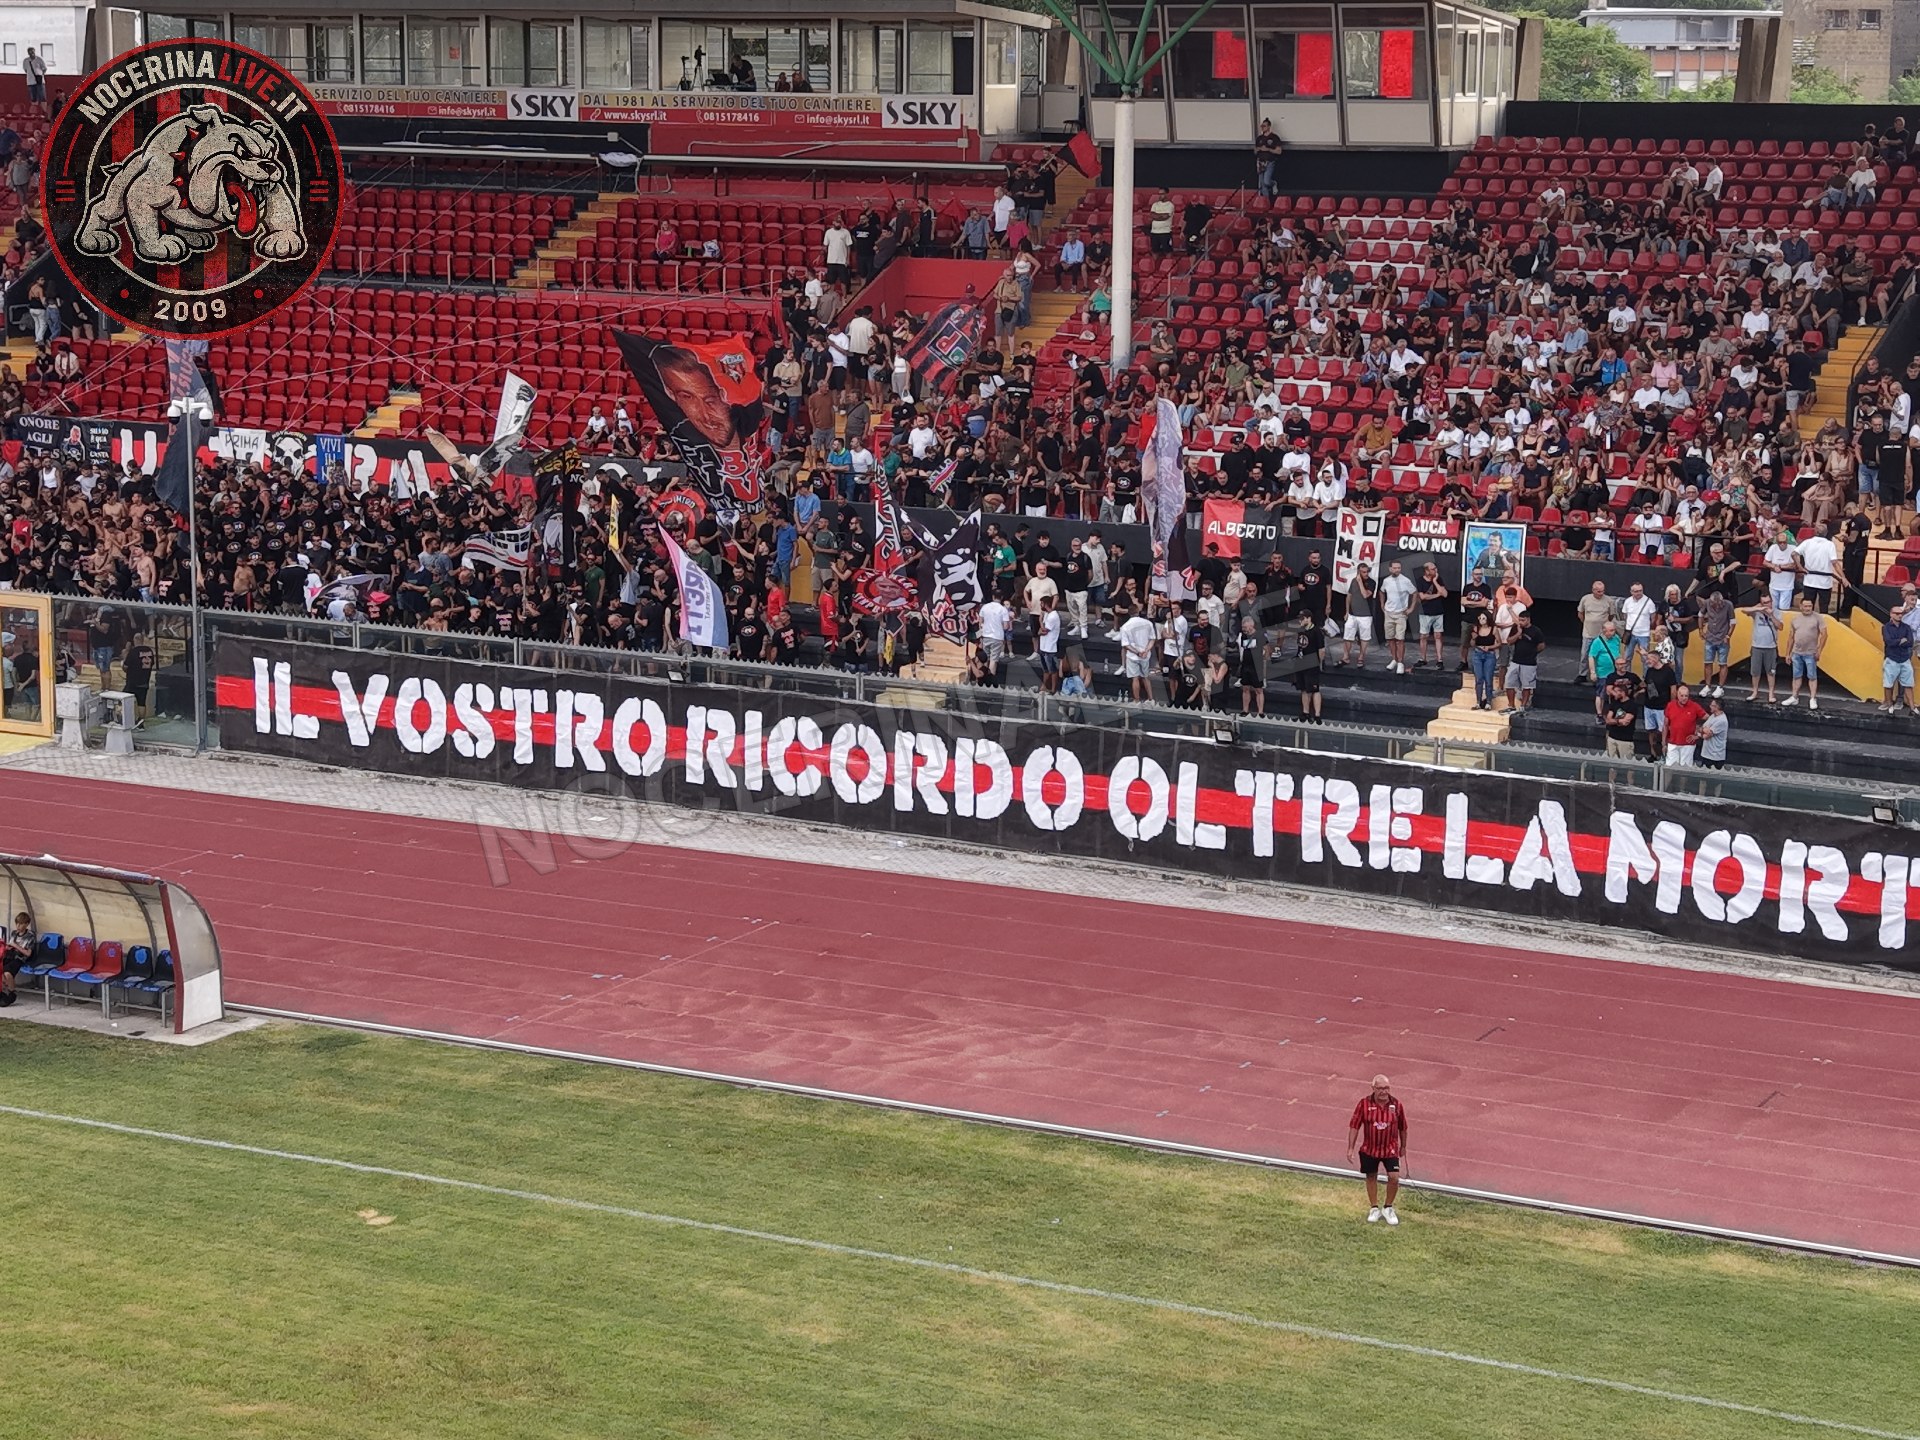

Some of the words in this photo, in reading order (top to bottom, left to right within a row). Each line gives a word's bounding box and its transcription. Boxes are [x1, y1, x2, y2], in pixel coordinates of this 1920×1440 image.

[314, 88, 372, 100] SERVIZIO
[377, 89, 401, 101] DEL
[405, 90, 430, 102] TUO
[583, 95, 609, 106] DAL
[615, 95, 644, 107] 1981
[651, 95, 668, 107] AL
[672, 96, 735, 108] SERVIZIO
[740, 96, 766, 109] DEL
[769, 97, 798, 110] TUO
[803, 98, 876, 111] CANTIERE.
[438, 105, 497, 118] info@skysrl.it
[525, 94, 575, 118] SKY
[902, 101, 957, 125] SKY
[603, 110, 668, 122] www.skysrl.it
[703, 111, 760, 123] 0815178416
[806, 113, 870, 127] info@skysrl.it
[19, 416, 60, 431] ONORE
[27, 431, 53, 444] AGLI
[320, 437, 341, 452] VIVI
[1207, 520, 1277, 541] ALBERTO
[1410, 518, 1447, 535] LUCA
[1398, 536, 1428, 552] CON
[1430, 537, 1457, 554] NOI
[252, 656, 320, 740] IL
[331, 669, 667, 777] VOSTRO
[685, 704, 1085, 831] RICORDO
[1604, 810, 1920, 950] MORT
